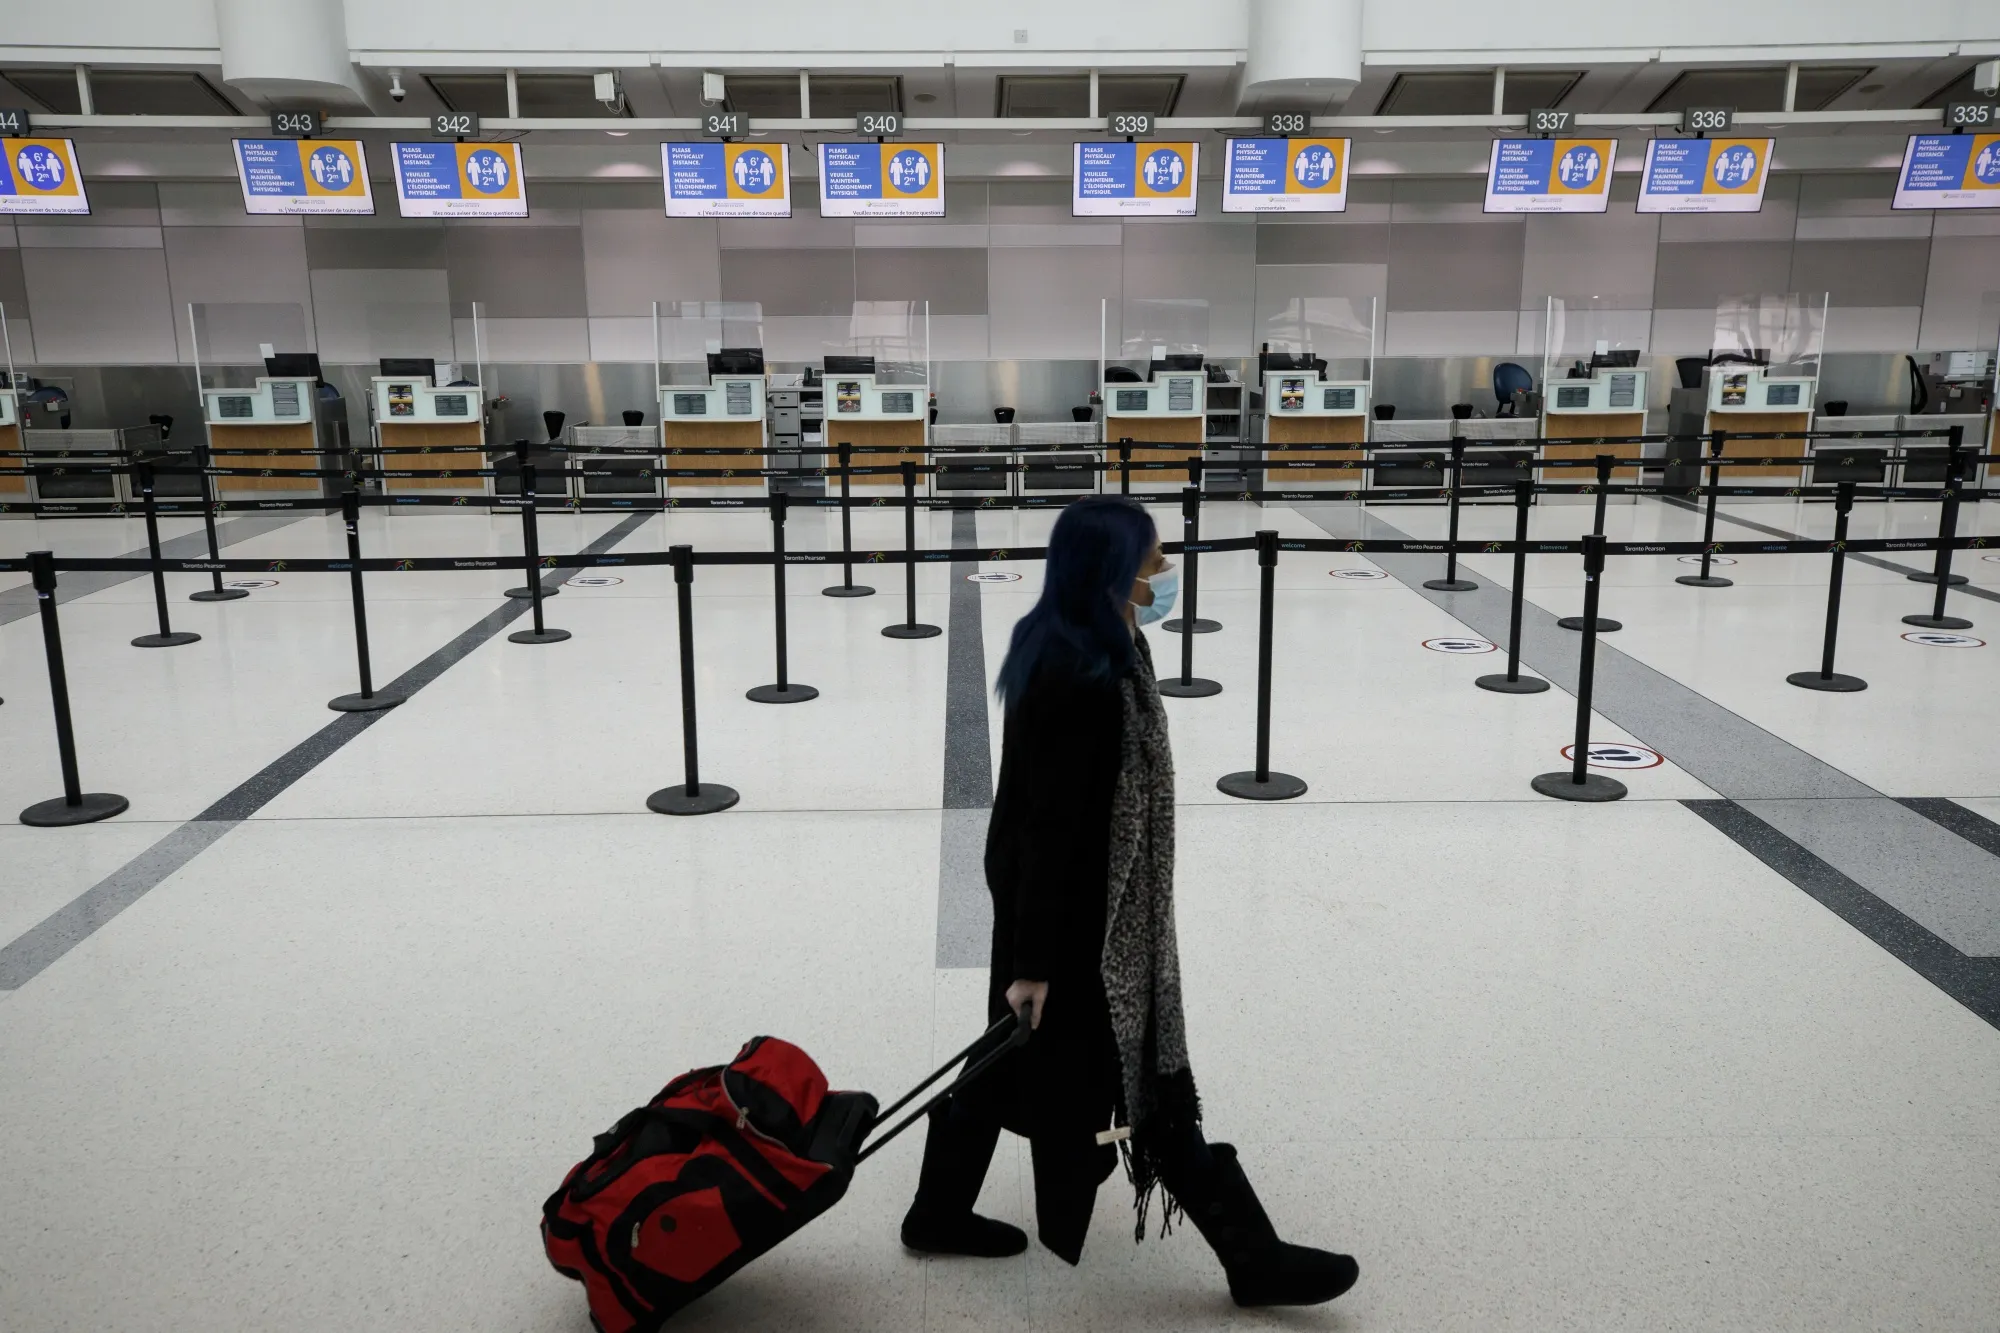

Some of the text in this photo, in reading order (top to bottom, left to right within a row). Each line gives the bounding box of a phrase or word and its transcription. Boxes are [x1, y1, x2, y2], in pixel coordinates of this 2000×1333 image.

[277, 114, 312, 130] 343
[1537, 113, 1569, 129] 337
[1692, 111, 1725, 128] 336
[1954, 106, 1988, 122] 335
[438, 116, 470, 132] 342
[709, 116, 737, 132] 341
[864, 116, 896, 132] 340
[1116, 116, 1148, 132] 339
[1272, 115, 1304, 131] 338
